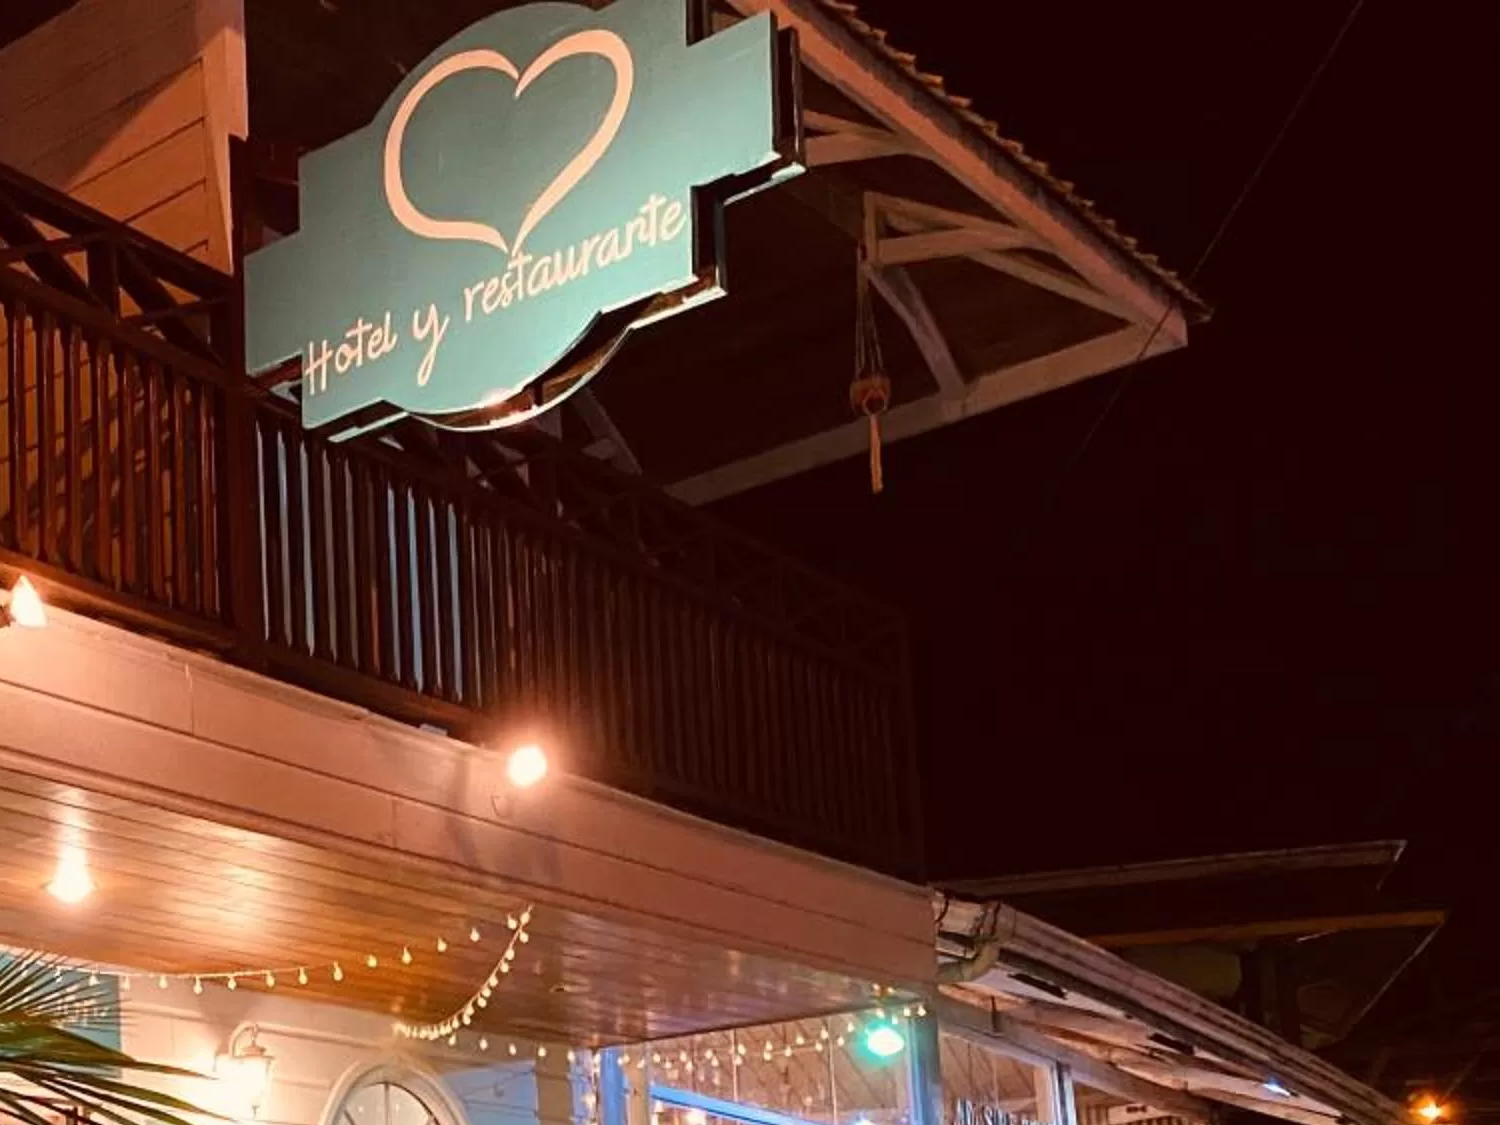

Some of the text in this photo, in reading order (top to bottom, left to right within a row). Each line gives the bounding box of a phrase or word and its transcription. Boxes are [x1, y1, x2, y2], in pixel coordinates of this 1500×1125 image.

[305, 193, 687, 396] Hotel y restaurante
